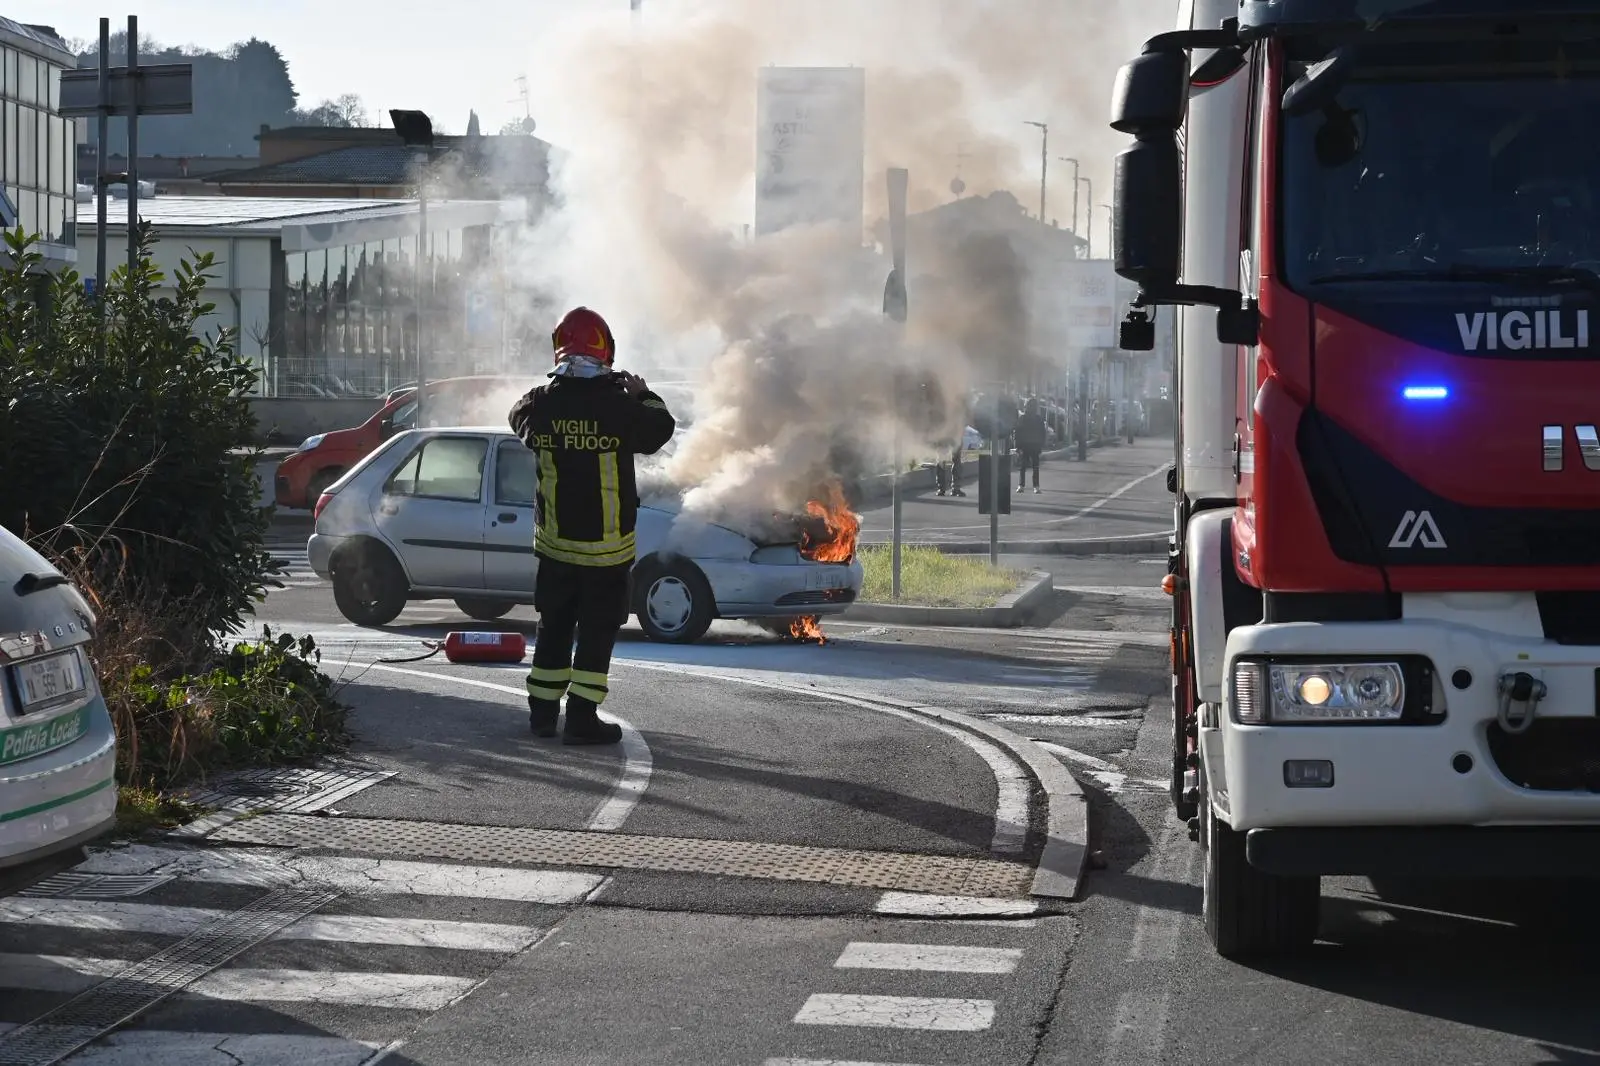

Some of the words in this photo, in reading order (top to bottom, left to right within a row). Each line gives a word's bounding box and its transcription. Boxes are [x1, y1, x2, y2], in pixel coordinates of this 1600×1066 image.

[1455, 310, 1588, 350] VIGILI
[551, 420, 598, 435] VIGILI
[531, 434, 558, 448] DEL
[564, 435, 620, 450] FUOCO
[2, 726, 48, 759] Polizia
